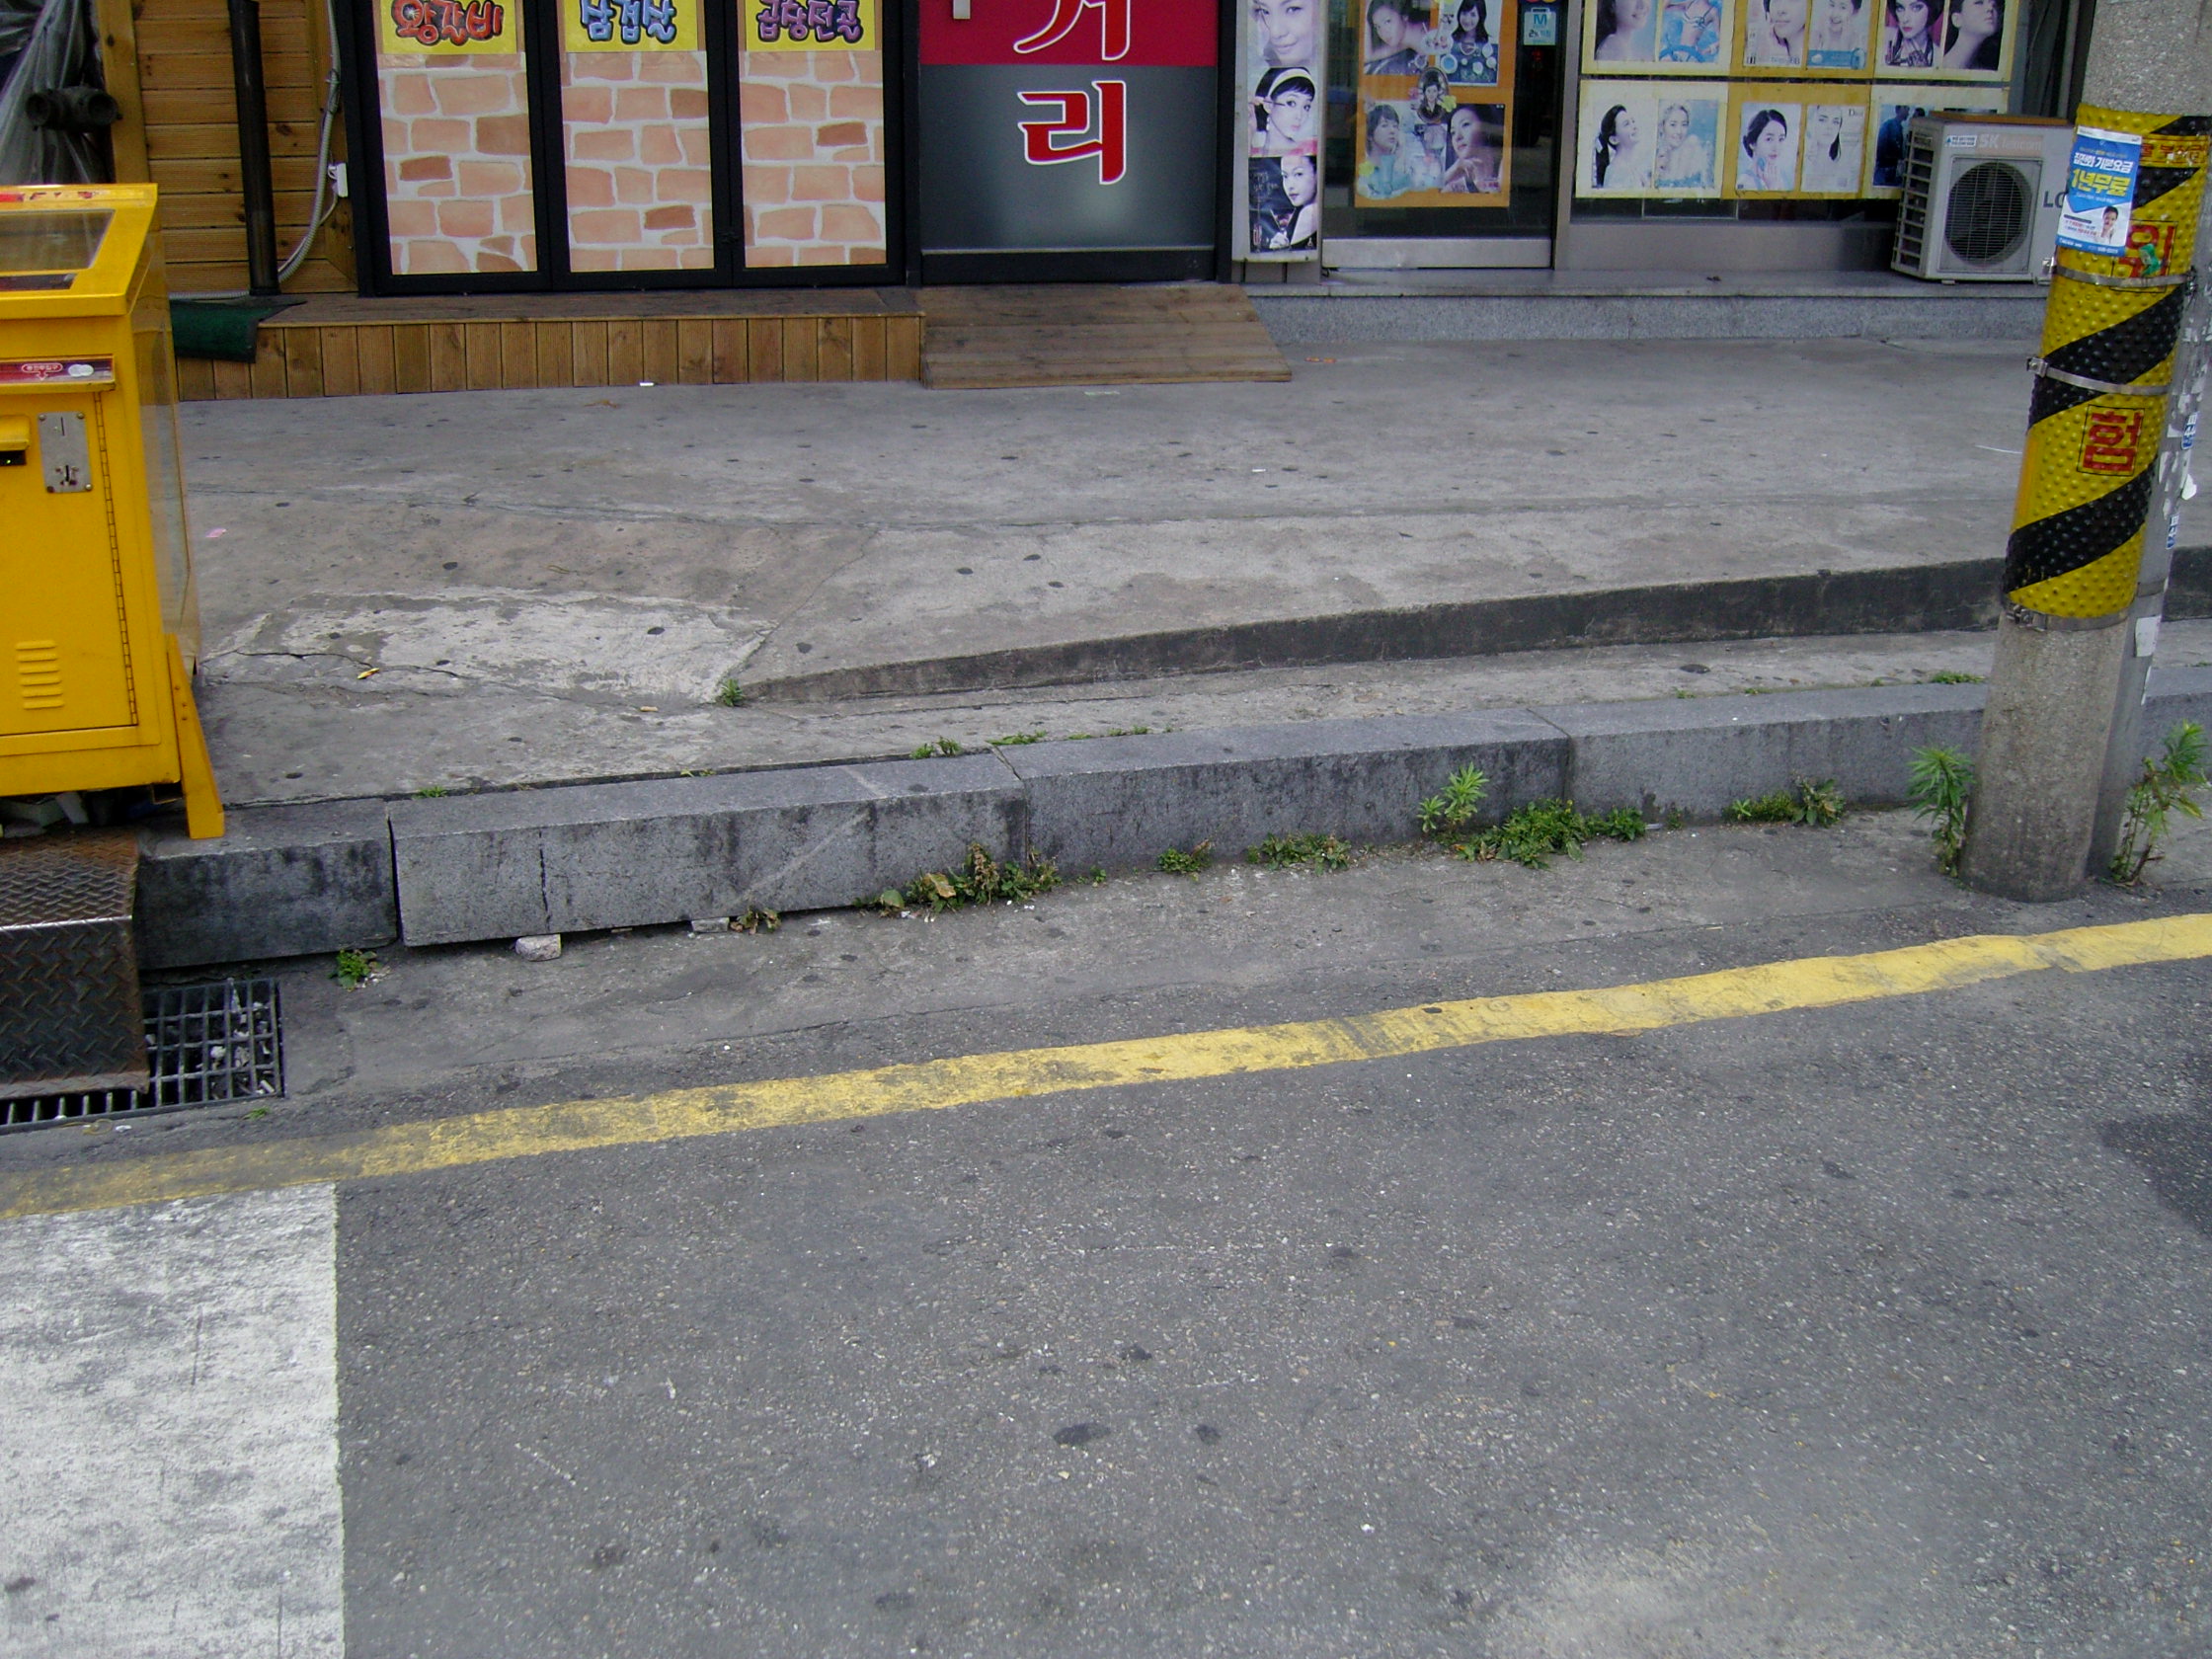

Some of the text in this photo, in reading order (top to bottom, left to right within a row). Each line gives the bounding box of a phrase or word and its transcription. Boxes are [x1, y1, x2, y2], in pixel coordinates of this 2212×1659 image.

[392, 0, 504, 45] 왕갈비
[581, 0, 676, 43] 삼겹살
[756, 0, 863, 42] 곱창전골
[2071, 168, 2131, 197] 1년무료
[2094, 157, 2134, 174] 기본요금
